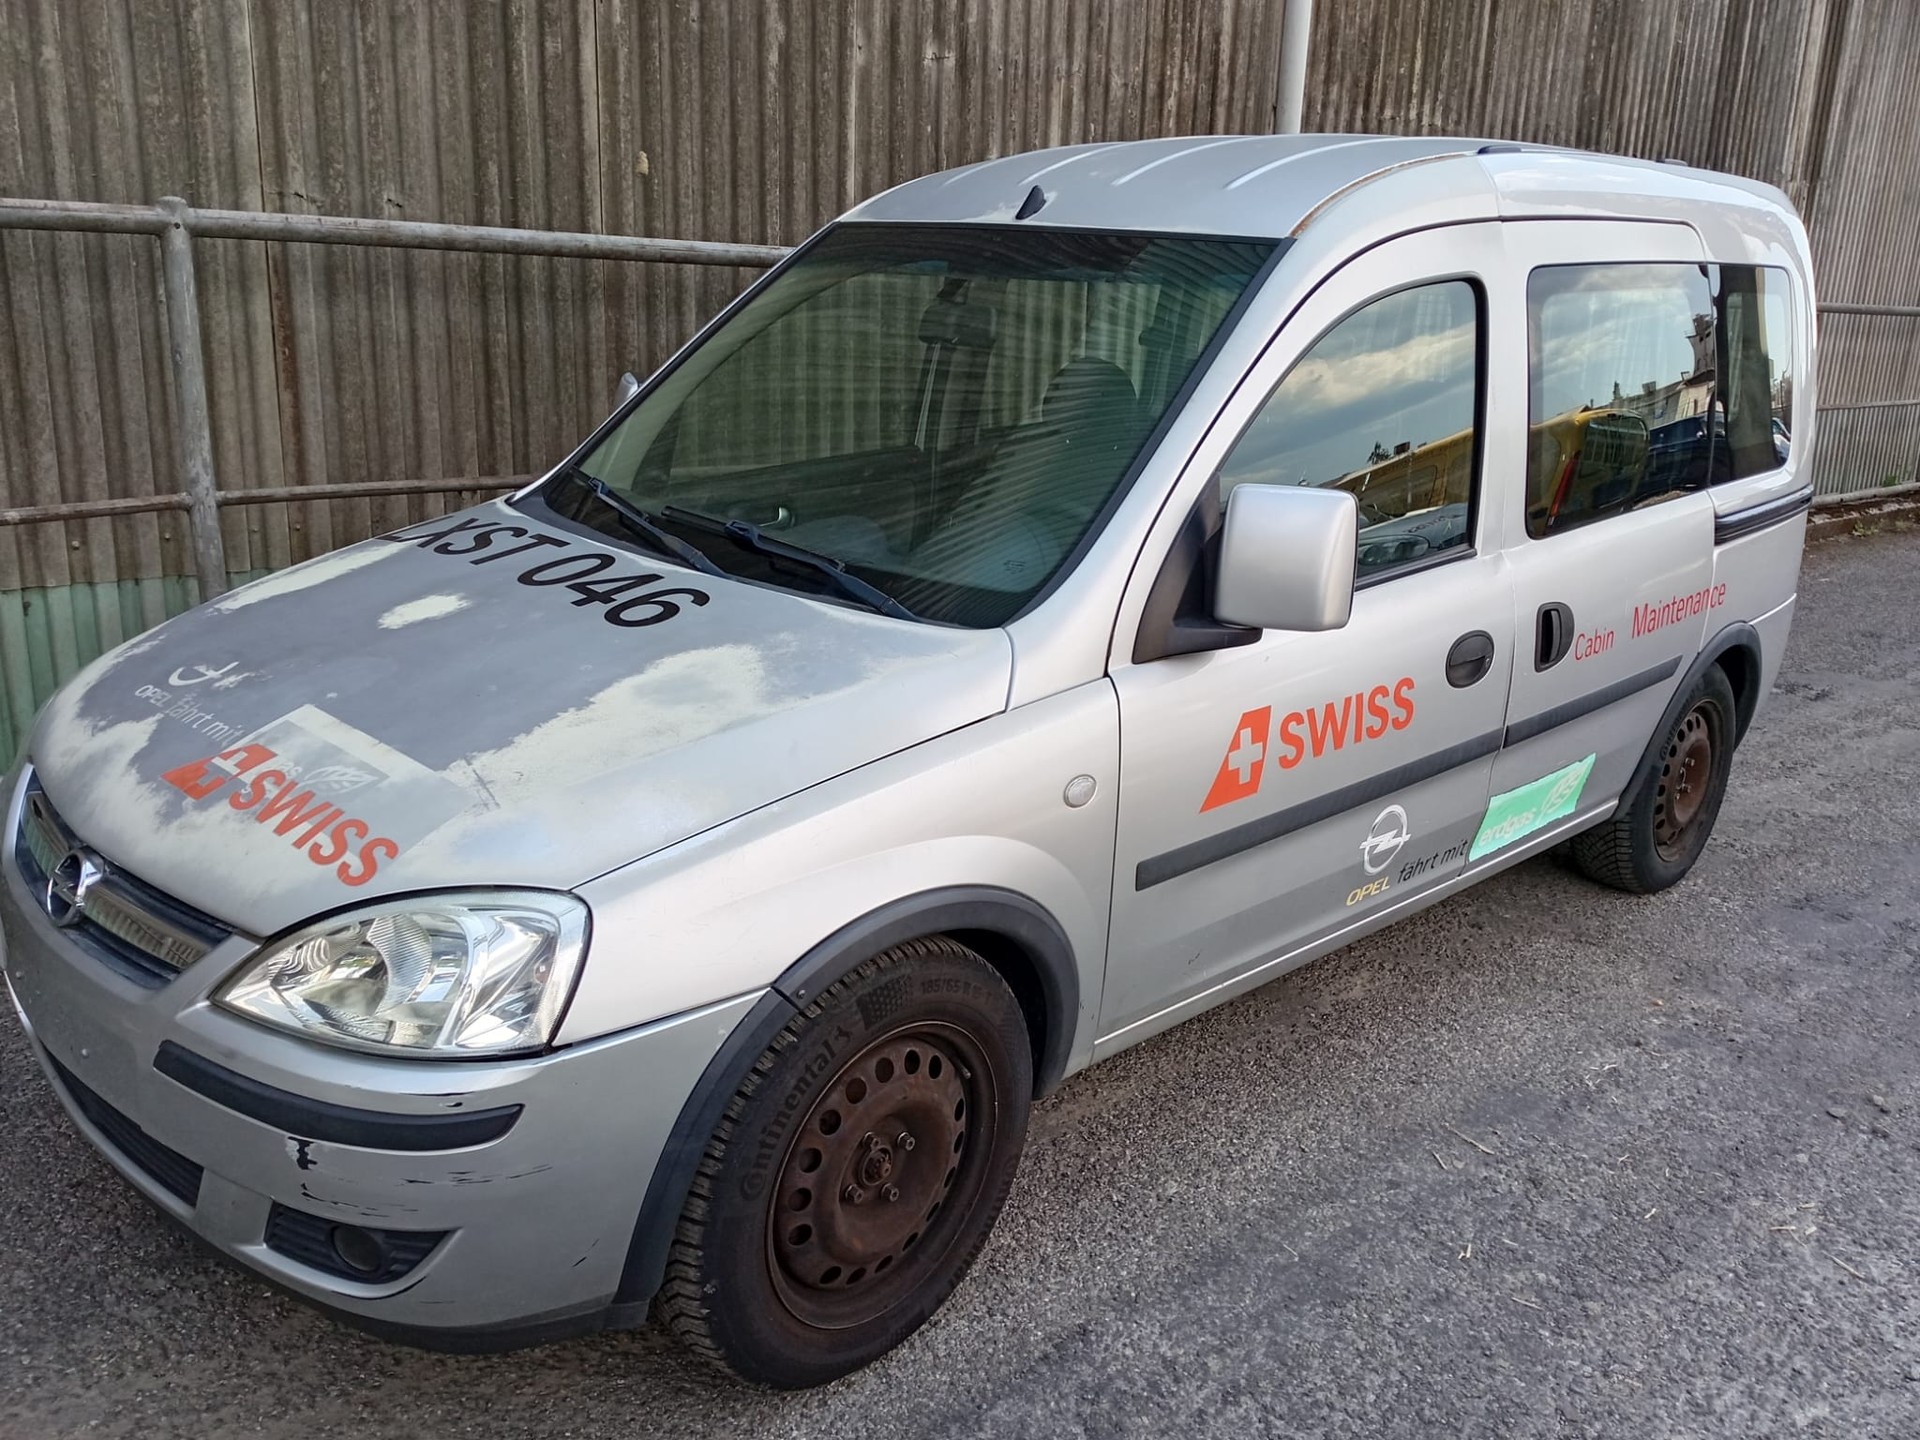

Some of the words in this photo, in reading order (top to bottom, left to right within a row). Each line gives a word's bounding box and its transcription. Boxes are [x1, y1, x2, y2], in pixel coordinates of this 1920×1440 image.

[517, 553, 711, 627] 046
[1574, 626, 1617, 661] Cabin
[1631, 583, 1727, 640] Maintenance
[135, 684, 172, 708] OPEL
[1278, 677, 1416, 770] SWISS
[228, 769, 400, 887] SWISS
[1346, 877, 1391, 906] OPEL
[1397, 853, 1440, 884] fährt
[1440, 839, 1469, 866] mit
[740, 1038, 838, 1202] Continental
